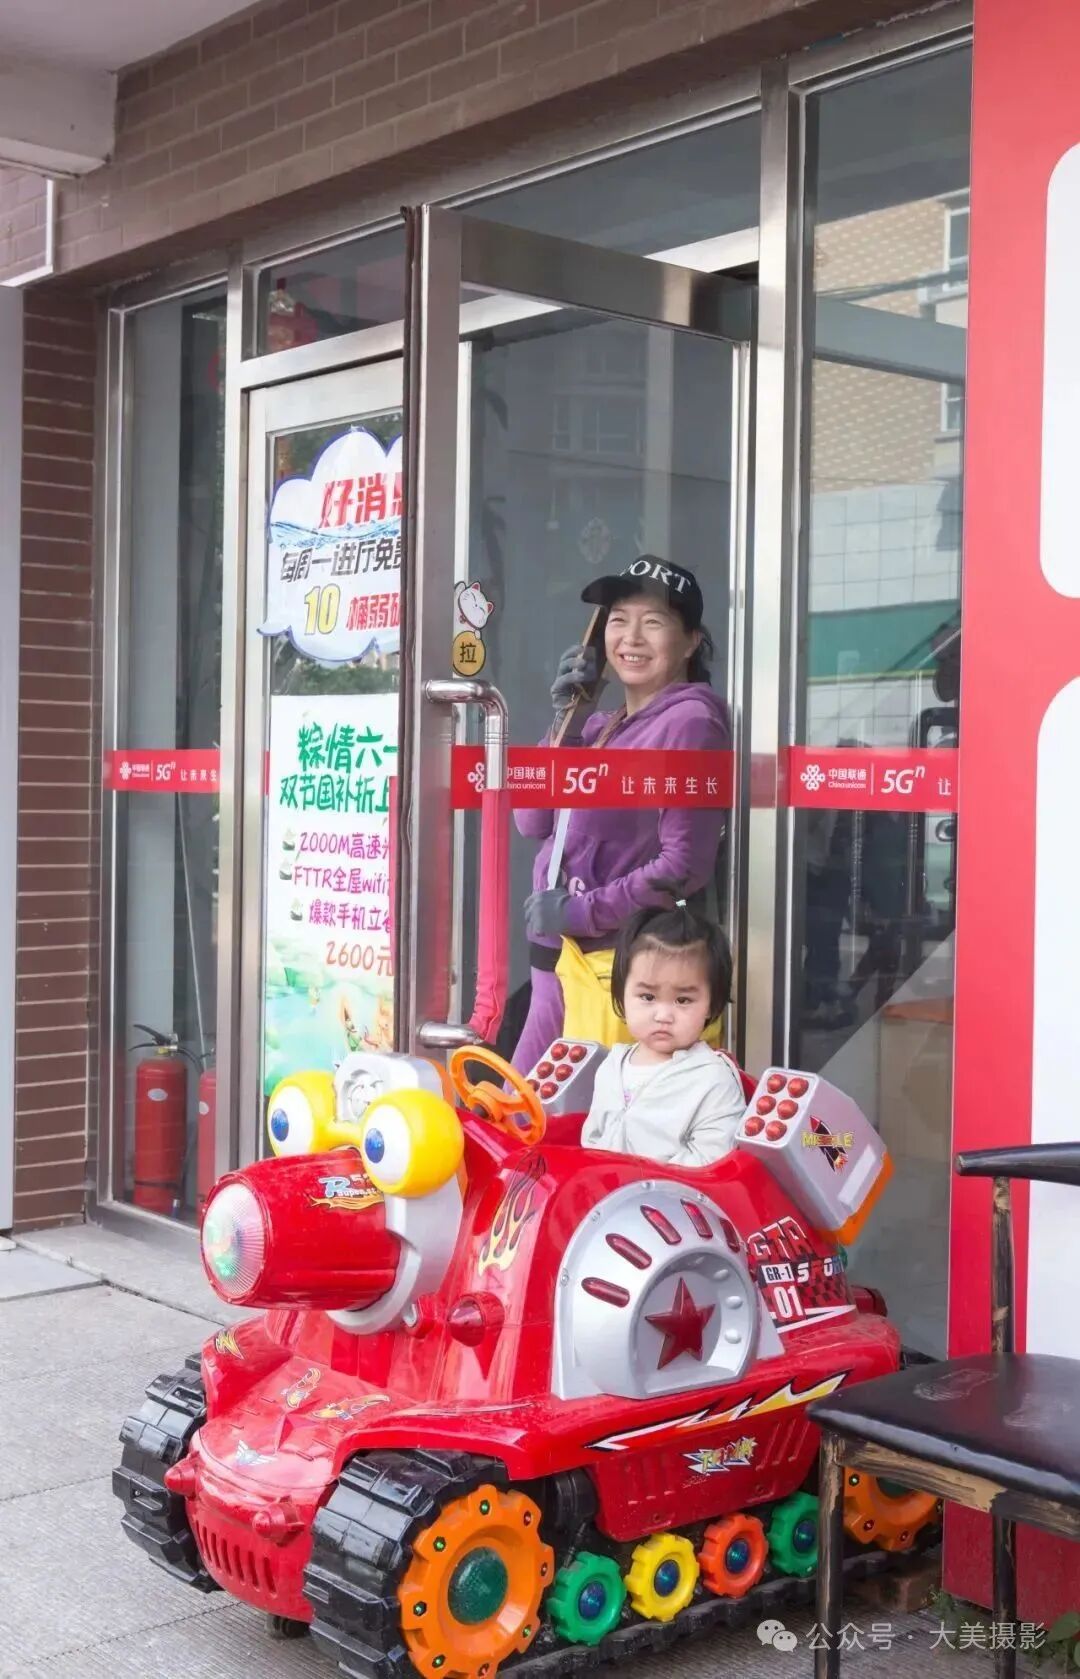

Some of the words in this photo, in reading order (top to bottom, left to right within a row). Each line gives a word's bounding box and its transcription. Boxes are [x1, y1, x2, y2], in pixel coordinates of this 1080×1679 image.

[619, 560, 692, 594] ORT
[304, 583, 341, 636] 10
[459, 642, 478, 664] 拉
[621, 776, 718, 795] 让未来生长
[828, 768, 867, 781] 中国联通
[937, 778, 952, 796] 让
[325, 940, 394, 977] 2600元
[765, 1266, 793, 1281] GR-1
[773, 1285, 804, 1319] 01
